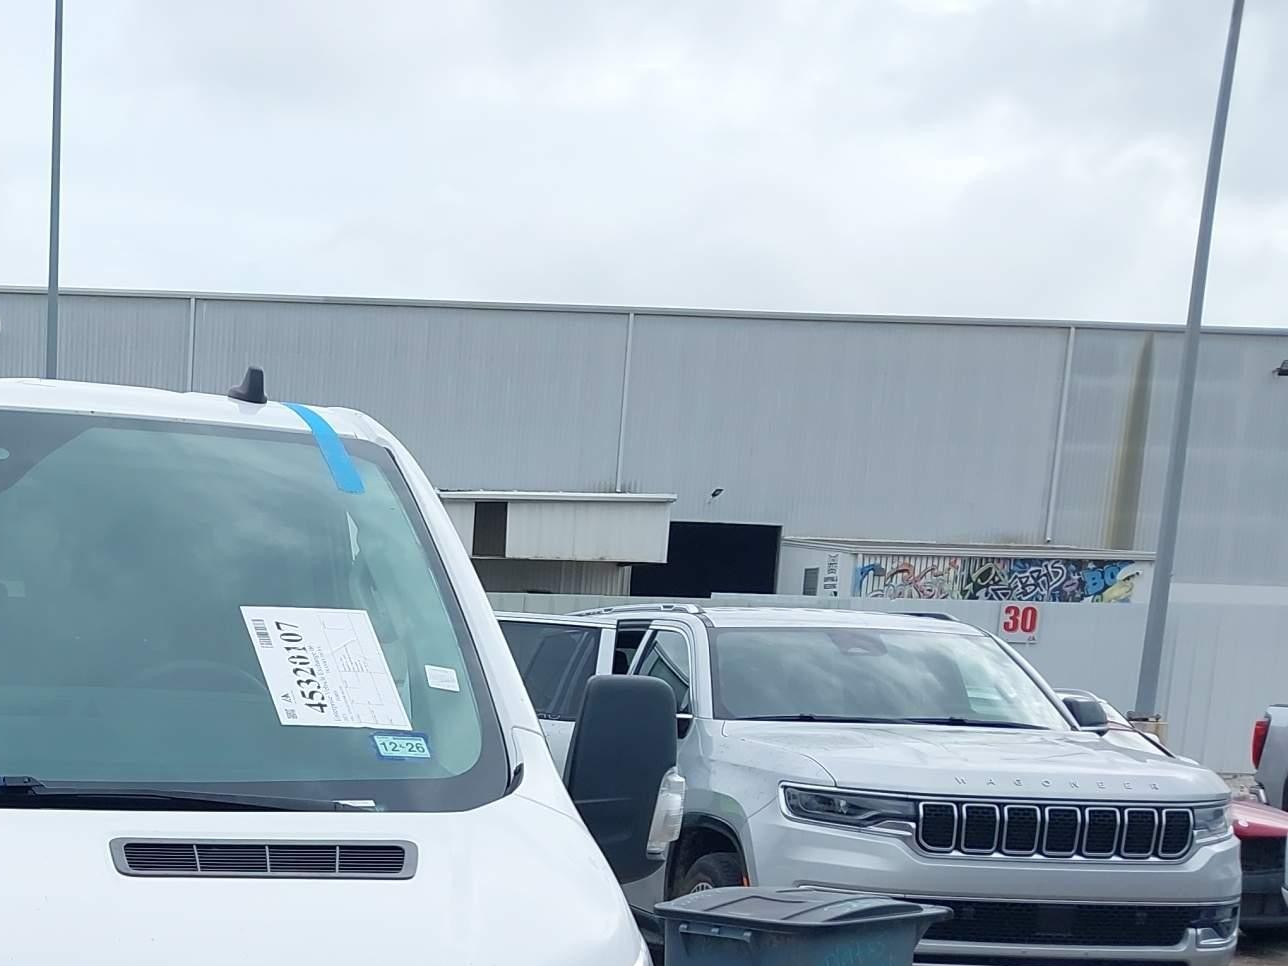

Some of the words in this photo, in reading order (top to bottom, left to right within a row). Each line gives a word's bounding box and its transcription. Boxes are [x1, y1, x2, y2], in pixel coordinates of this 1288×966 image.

[1003, 605, 1038, 633] 30
[274, 620, 328, 714] 45320107
[953, 775, 1159, 791] WAGONEER
